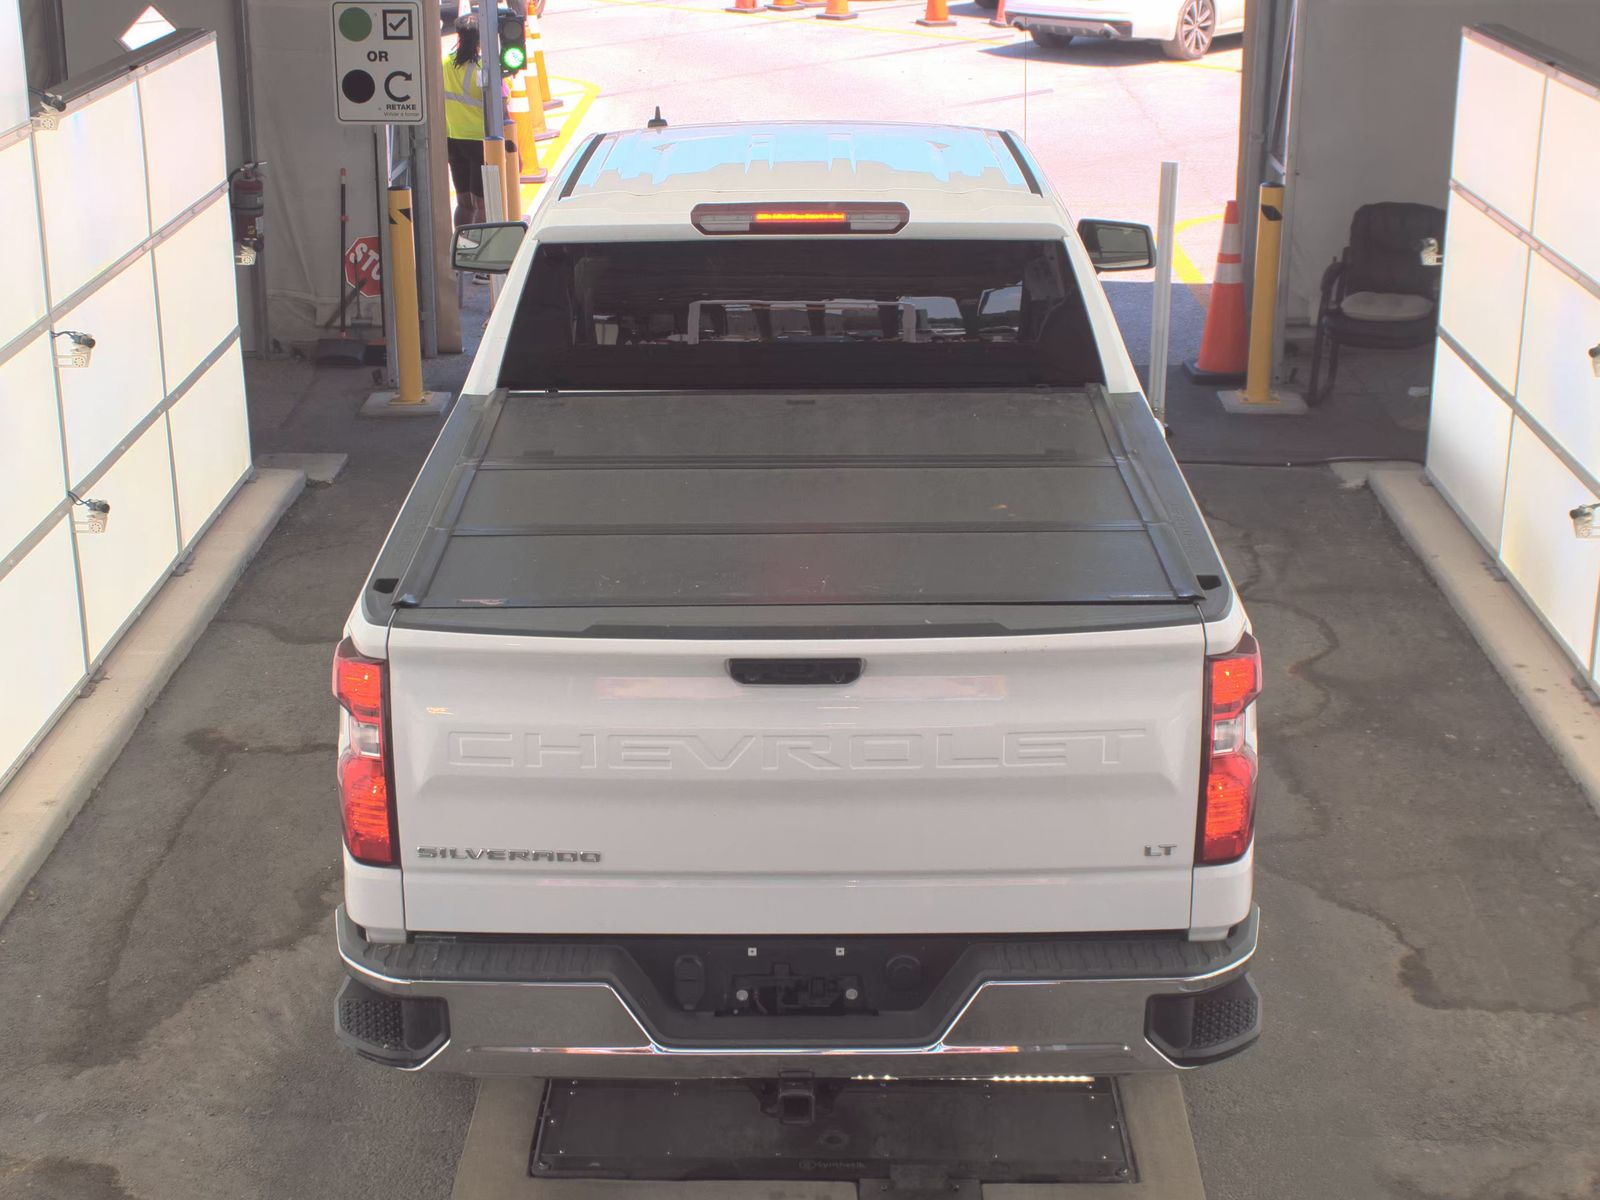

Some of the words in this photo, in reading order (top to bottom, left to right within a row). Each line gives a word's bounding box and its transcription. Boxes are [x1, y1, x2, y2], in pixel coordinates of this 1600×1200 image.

[366, 50, 389, 62] OR
[448, 728, 1148, 770] CHEVROLET
[417, 846, 602, 863] SILVERADO
[1144, 844, 1177, 857] LT
